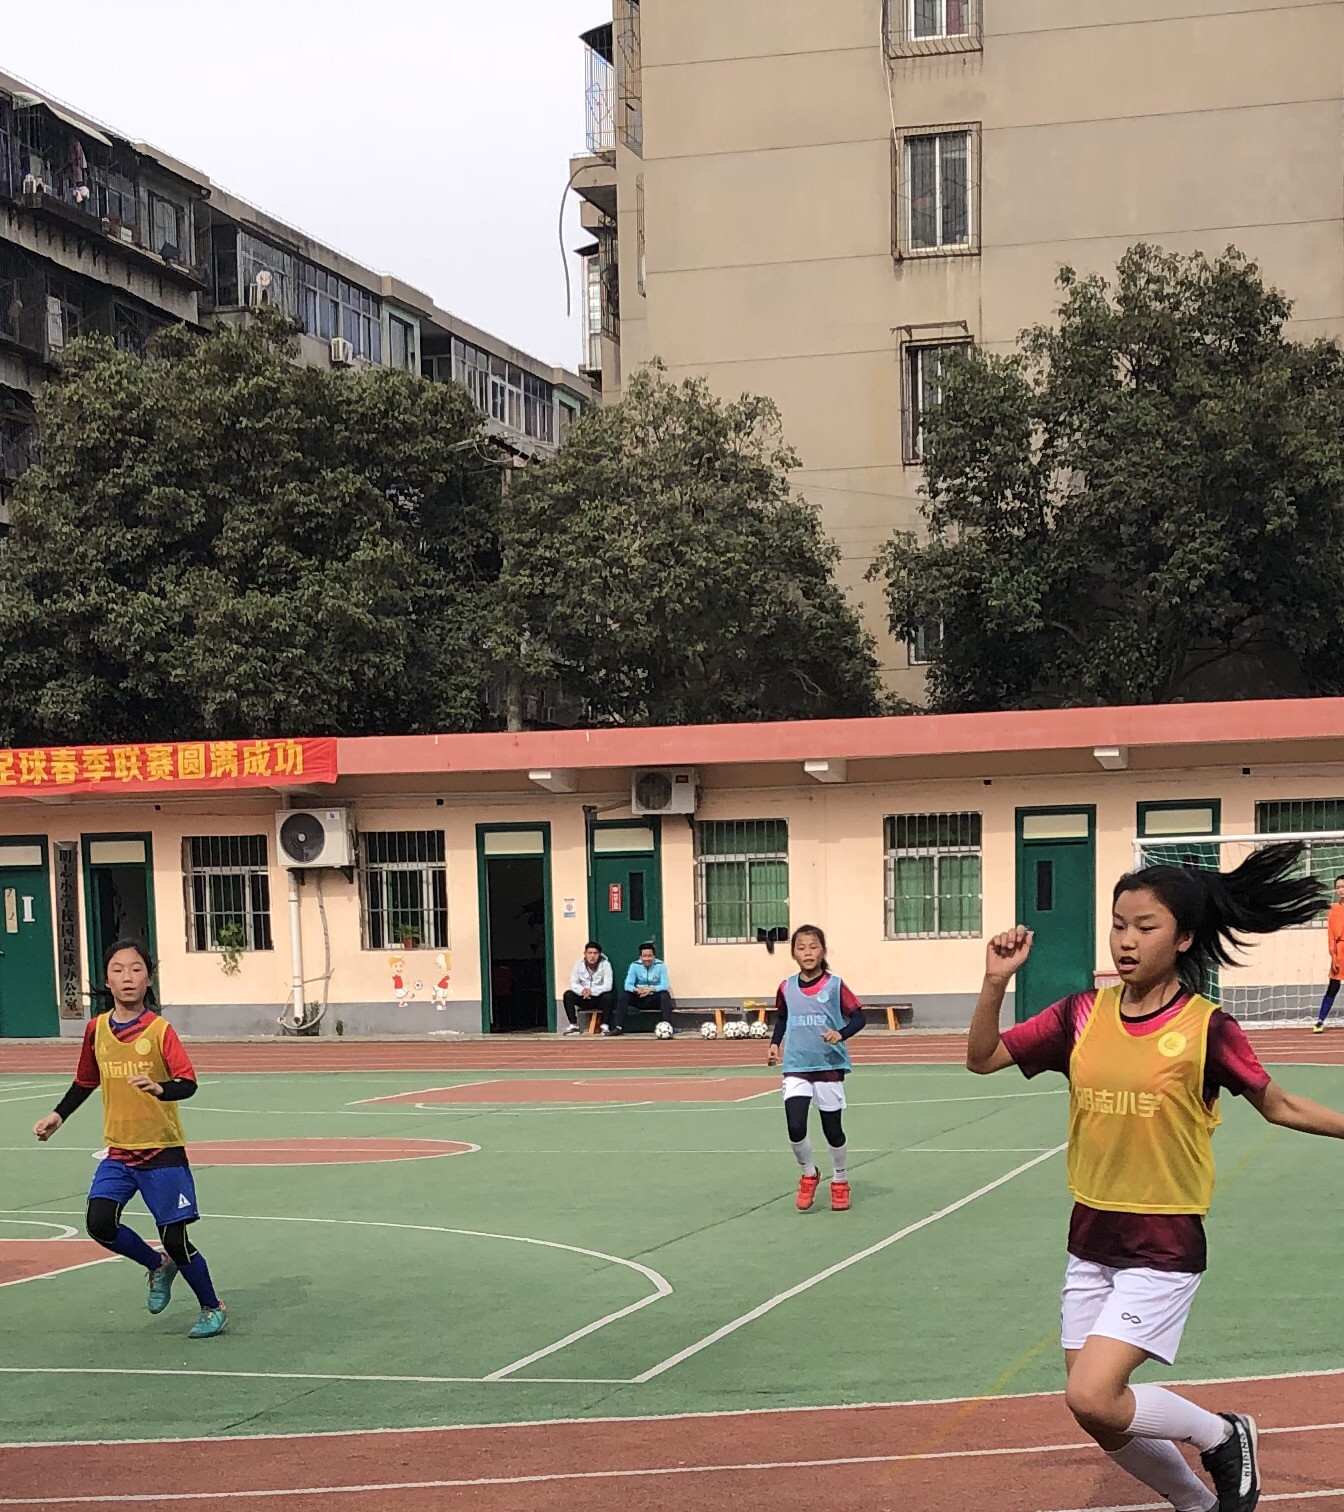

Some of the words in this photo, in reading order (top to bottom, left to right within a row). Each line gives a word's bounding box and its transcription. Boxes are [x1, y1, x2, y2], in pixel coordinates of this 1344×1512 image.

[58, 849, 78, 1011] 明志小学校园足球办公室
